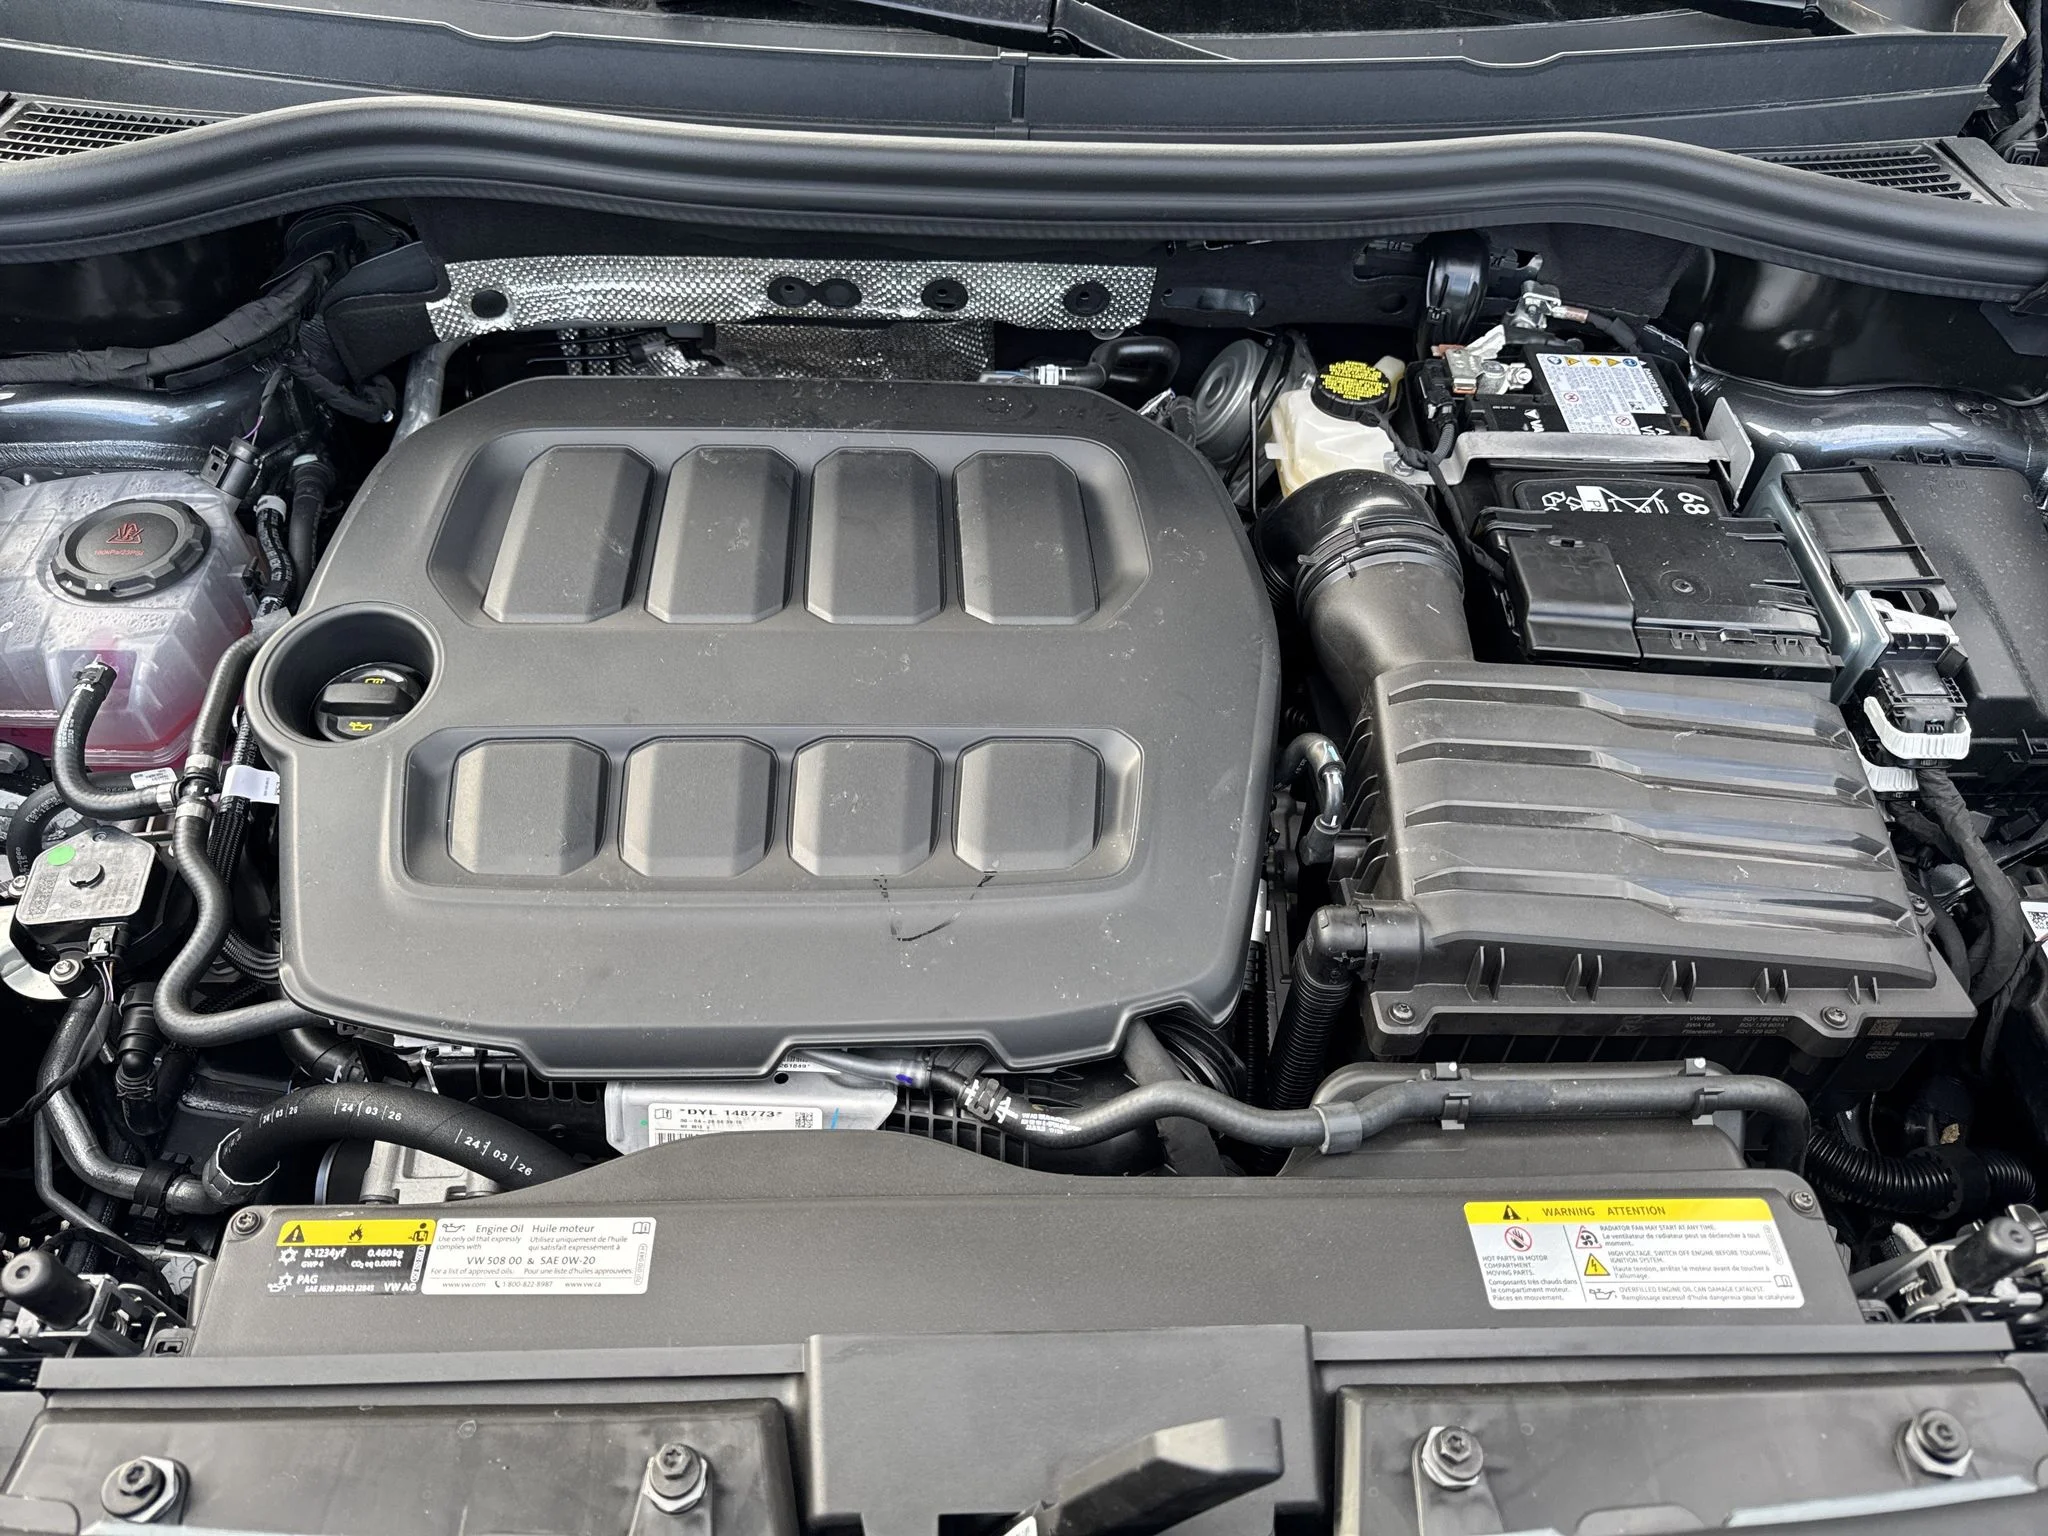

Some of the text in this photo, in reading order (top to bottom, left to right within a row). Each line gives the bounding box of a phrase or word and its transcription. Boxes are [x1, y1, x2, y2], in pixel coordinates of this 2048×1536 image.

[341, 1103, 402, 1121] 24 03 26
[464, 1136, 533, 1176] 24 03 26
[1542, 1206, 1666, 1217] WARNING ATTENTION
[476, 1224, 524, 1235] Engine Oil
[532, 1224, 595, 1233] Huile moteur
[304, 1248, 347, 1260] R-1234yf
[393, 1248, 405, 1259] kg
[467, 1256, 596, 1265] VW 508 00 & SAE 0W-20
[296, 1274, 319, 1285] PAG
[384, 1282, 401, 1292] VW
[401, 1282, 417, 1292] AG
